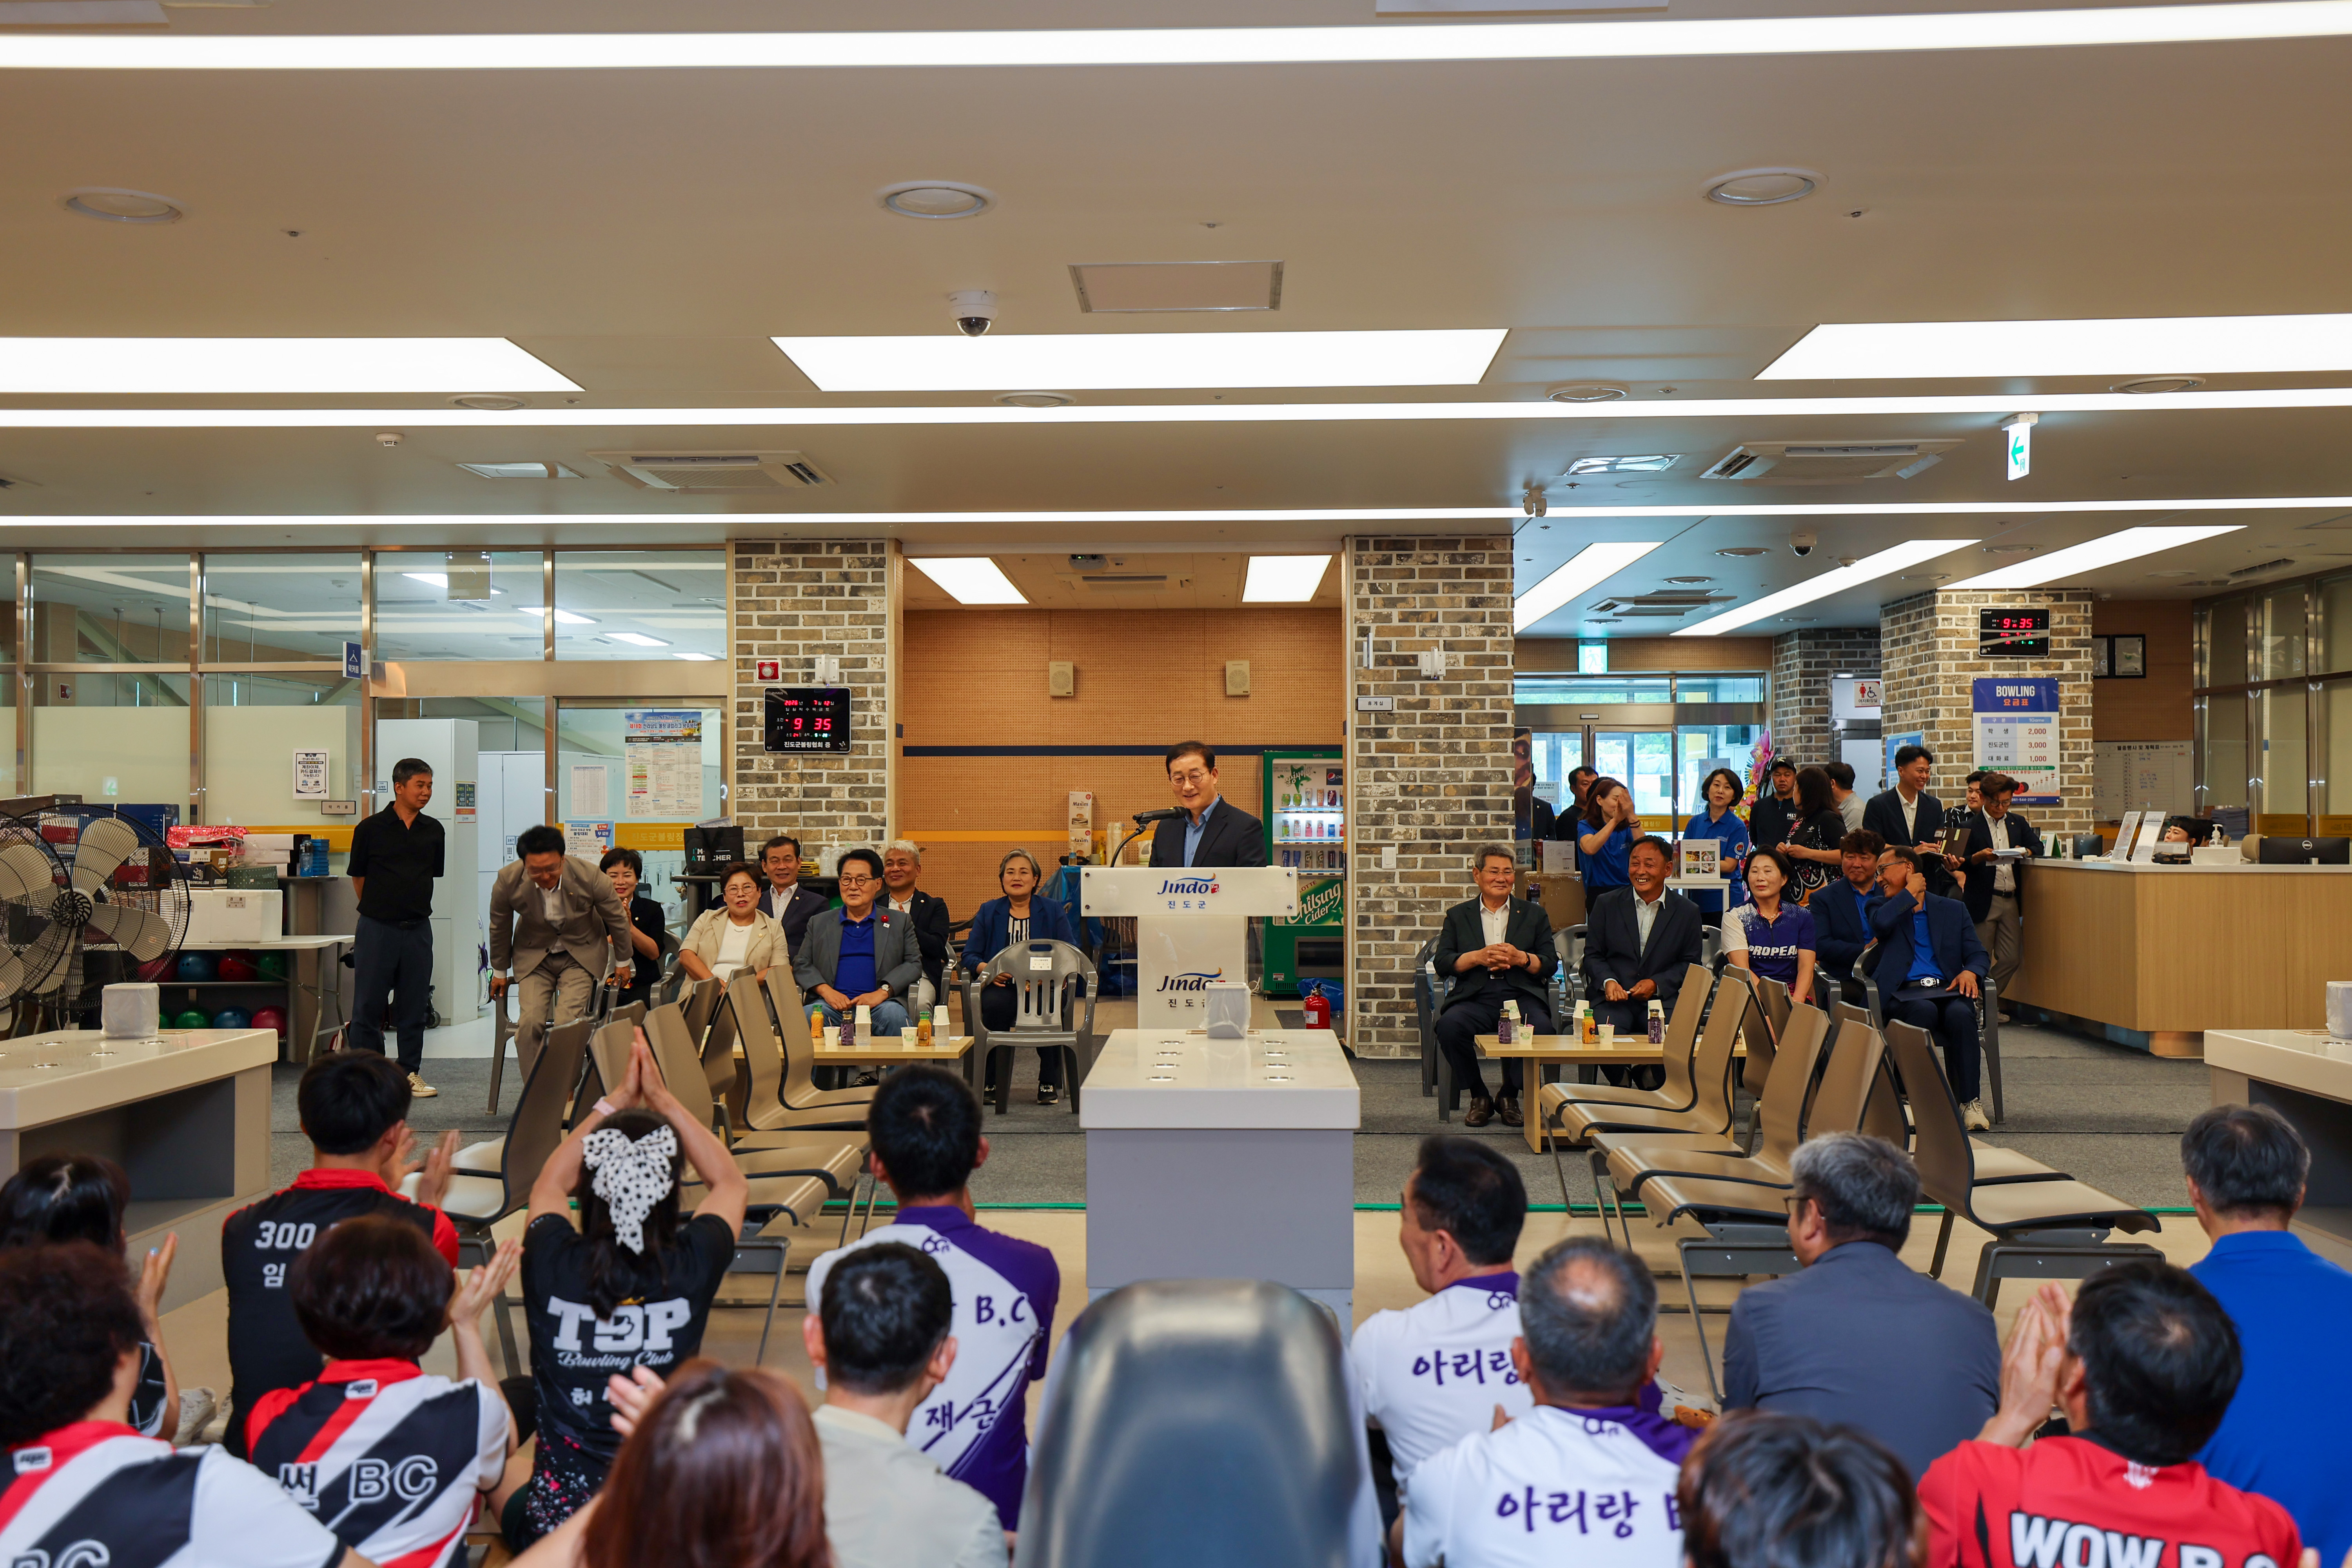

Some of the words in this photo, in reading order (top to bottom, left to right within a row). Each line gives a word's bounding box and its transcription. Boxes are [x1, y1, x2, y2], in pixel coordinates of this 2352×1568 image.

[2003, 618, 2011, 628] 9
[2019, 618, 2033, 628] 35
[348, 664, 359, 674] 락커룸
[1996, 686, 2035, 697] BOWLING
[793, 718, 803, 730] 9
[813, 718, 831, 730] 35
[632, 832, 684, 842] 진도군볼링장
[1157, 880, 1209, 895] Jindo
[1168, 900, 1206, 909] 진도군
[254, 1220, 317, 1250] 300
[262, 1263, 287, 1289] 임
[976, 1295, 1027, 1327] B.C
[557, 1351, 632, 1371] Bowling
[633, 1350, 675, 1367] Club
[570, 1387, 593, 1406] 허
[348, 1454, 438, 1505] BC
[1497, 1485, 1640, 1538] 아리랑
[2009, 1509, 2166, 1568] WOW
